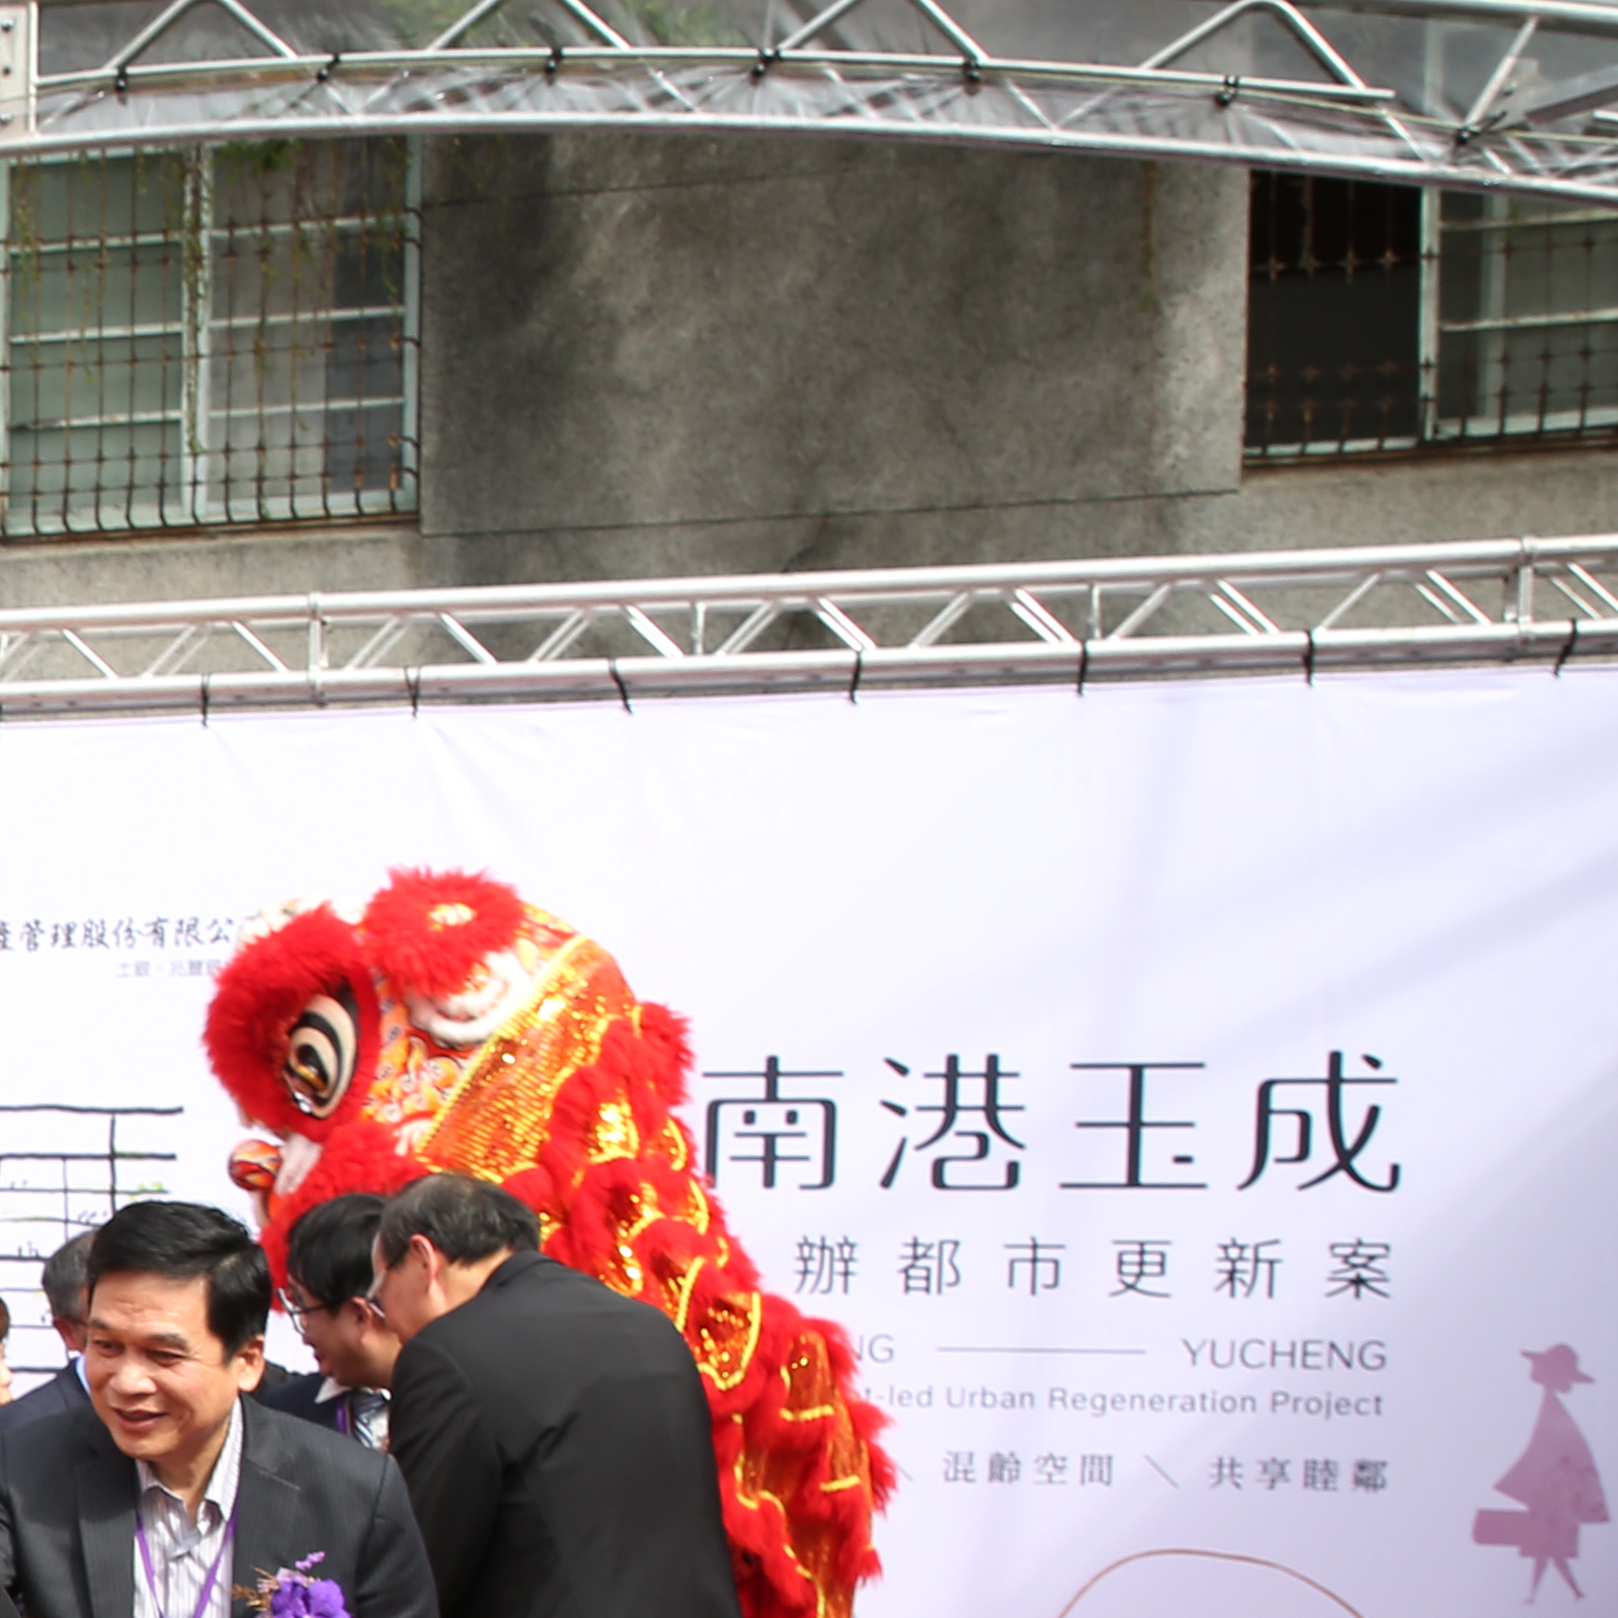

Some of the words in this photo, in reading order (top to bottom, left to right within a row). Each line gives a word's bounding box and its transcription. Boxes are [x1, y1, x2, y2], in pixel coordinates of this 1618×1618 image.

[702, 1050, 1402, 1194] 南港玉成
[793, 1233, 1393, 1301] 辦都市更新案
[1181, 1338, 1388, 1371] YUCHENG
[945, 1385, 1035, 1410] Urban
[1049, 1387, 1257, 1417] Regeneration
[1272, 1391, 1384, 1420] Project
[943, 1450, 1114, 1486] 混齡空間
[1210, 1455, 1389, 1493] 共享睦鄰
